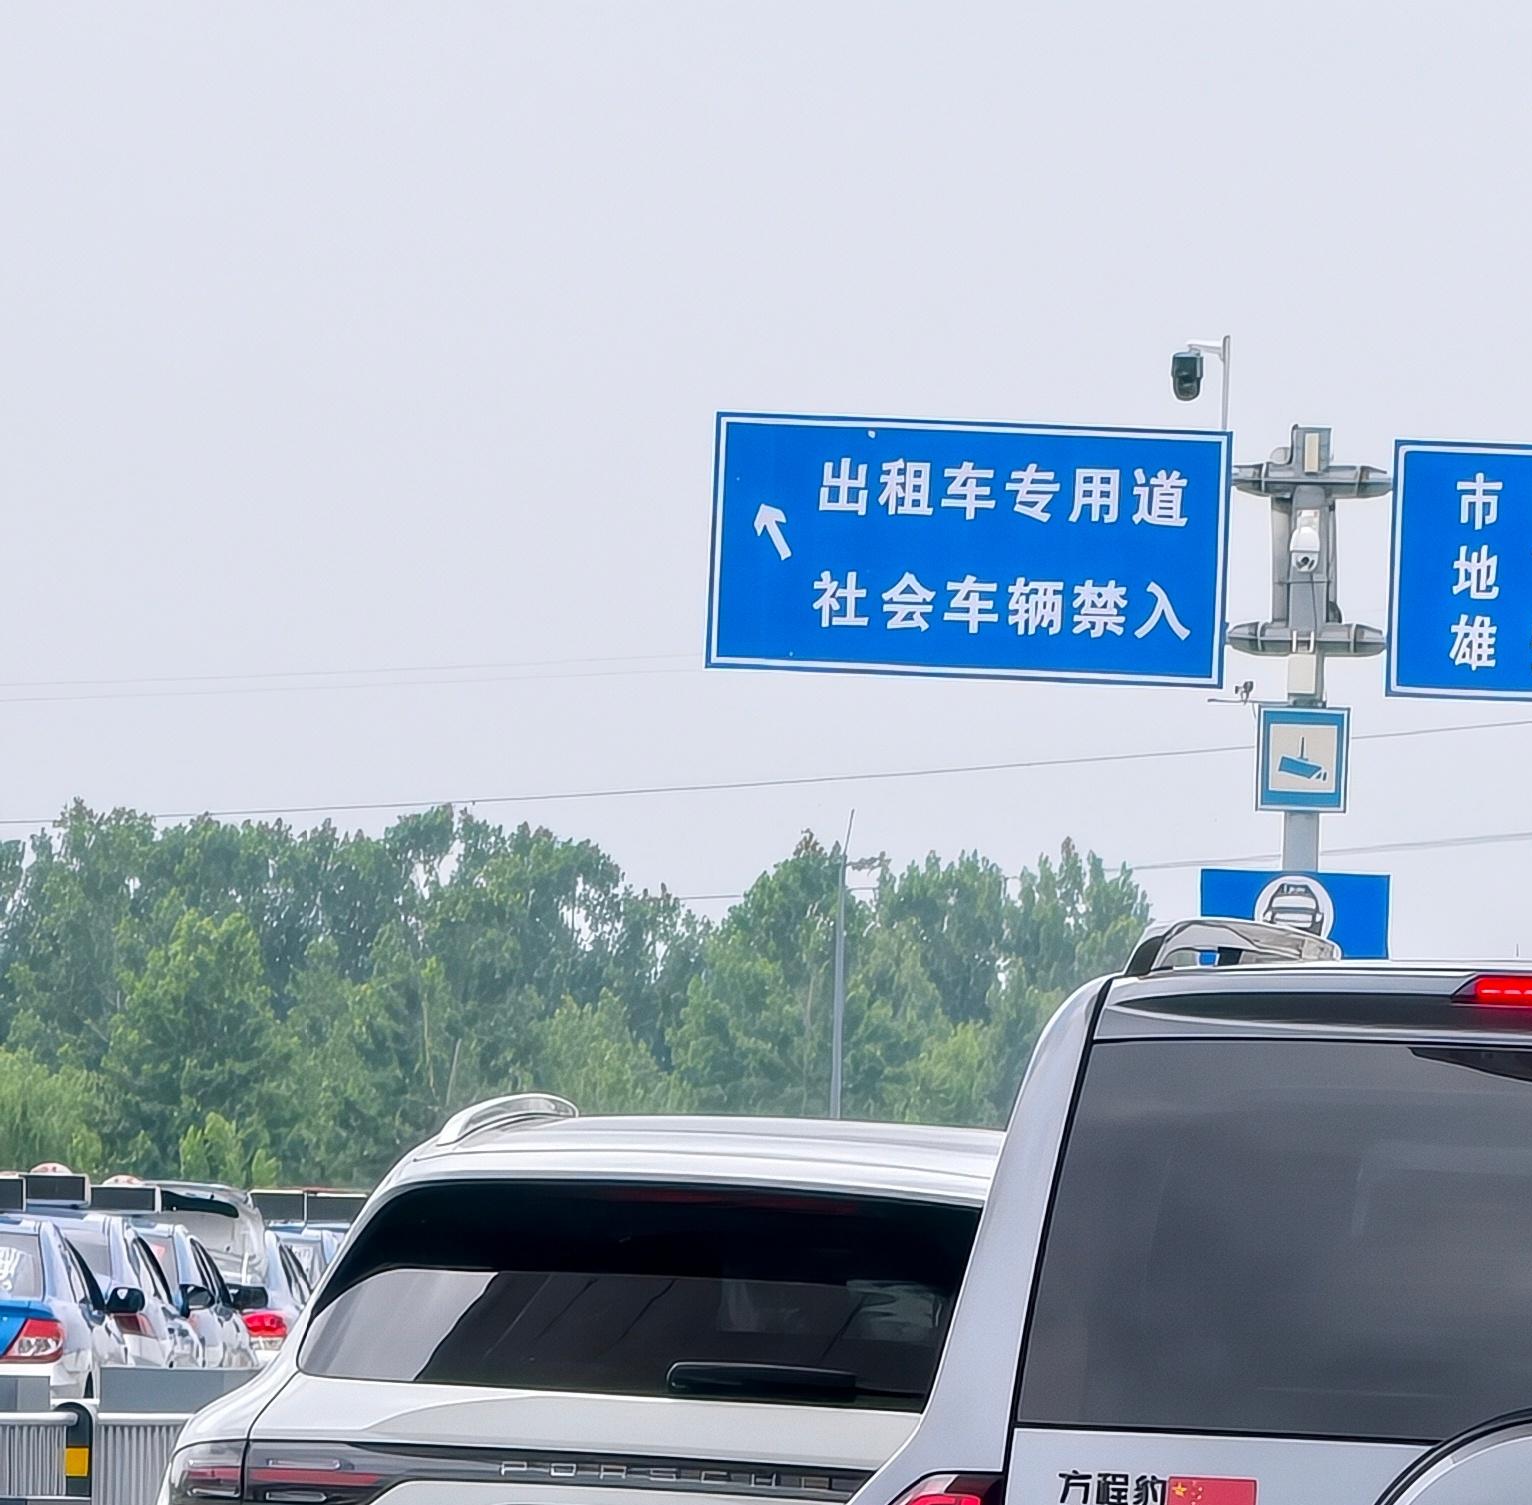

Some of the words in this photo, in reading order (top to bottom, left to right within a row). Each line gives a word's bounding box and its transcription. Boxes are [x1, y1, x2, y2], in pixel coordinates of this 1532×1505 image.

[819, 457, 1189, 527] 出租车专用道
[813, 571, 1191, 641] 社会车辆禁入
